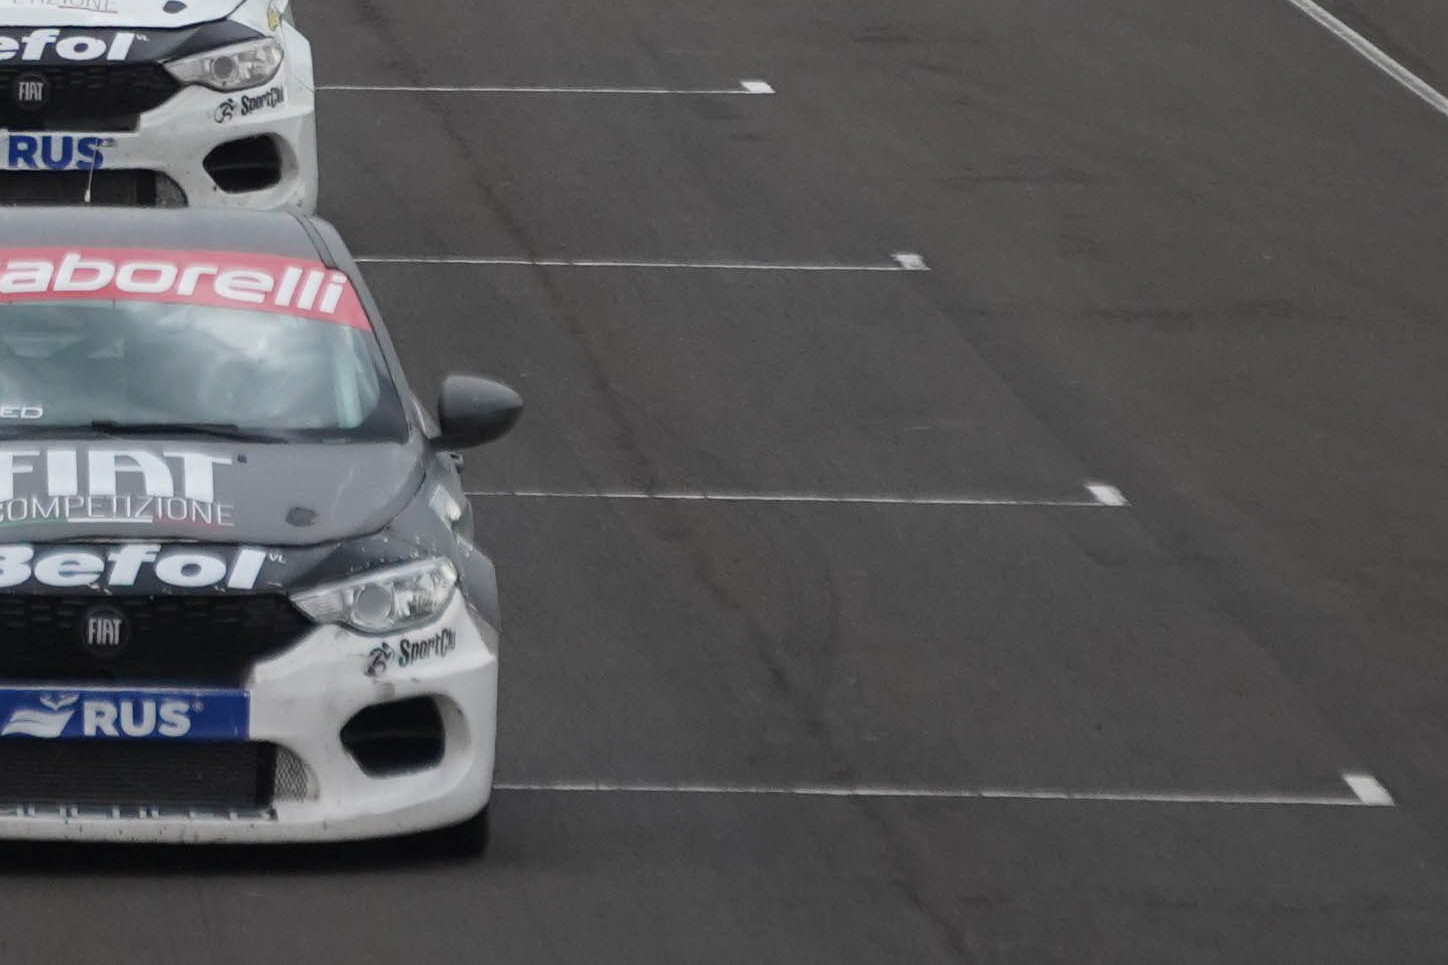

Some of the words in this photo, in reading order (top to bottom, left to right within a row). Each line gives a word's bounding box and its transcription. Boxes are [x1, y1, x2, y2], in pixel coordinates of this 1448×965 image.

[18, 81, 44, 102] FIAT
[8, 135, 104, 171] RUS
[88, 617, 122, 645] FIAT
[83, 699, 192, 737] RUS
